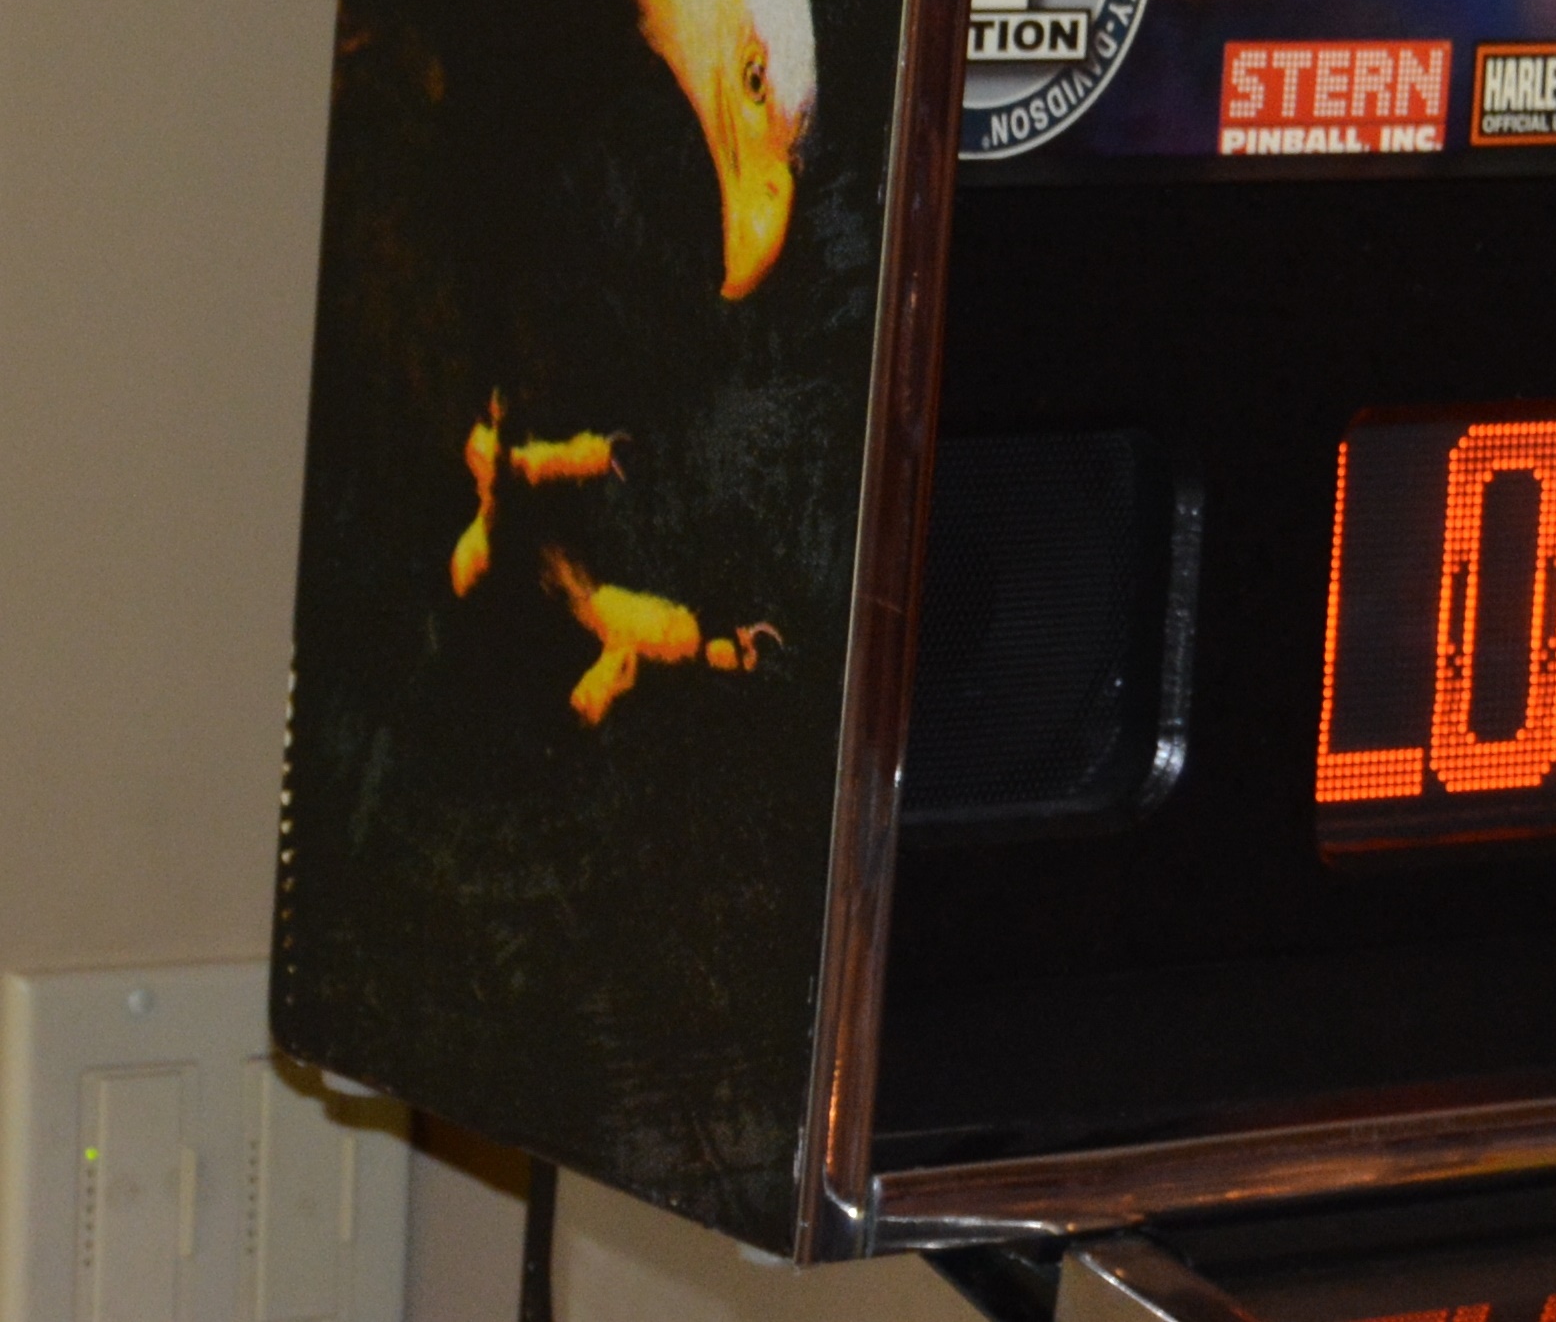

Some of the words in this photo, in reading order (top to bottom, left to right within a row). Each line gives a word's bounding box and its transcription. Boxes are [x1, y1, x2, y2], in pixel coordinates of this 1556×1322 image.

[1229, 49, 1444, 118] STERN
[1482, 112, 1549, 134] OFFICIAL
[1380, 125, 1443, 153] INC.
